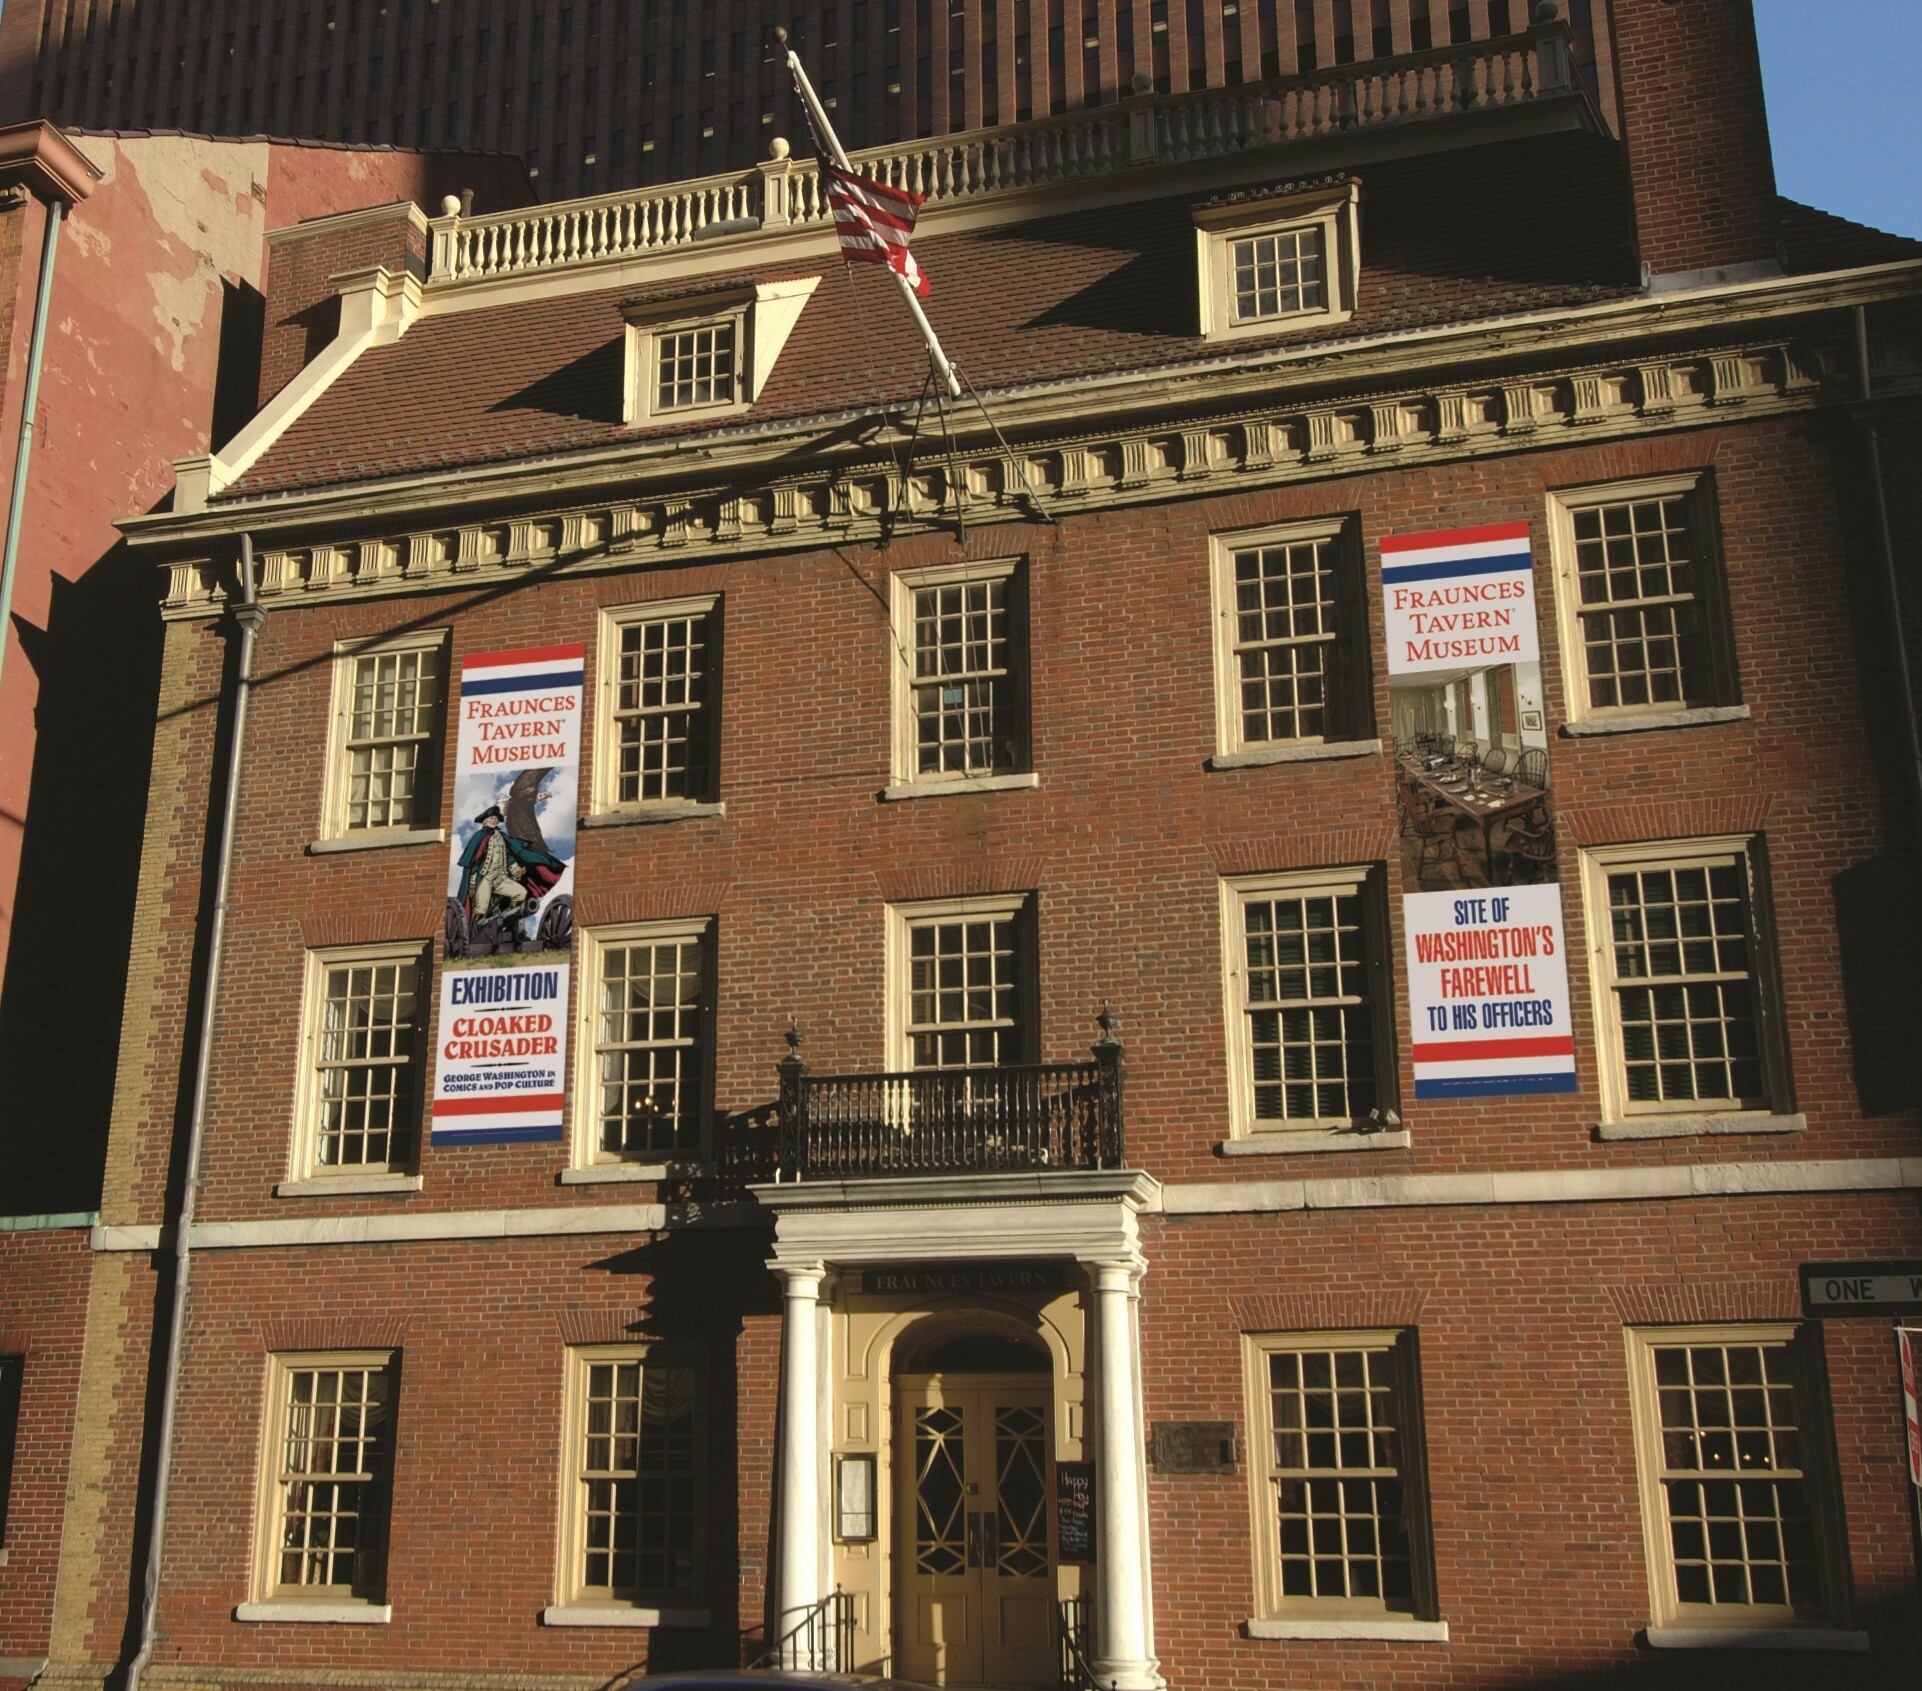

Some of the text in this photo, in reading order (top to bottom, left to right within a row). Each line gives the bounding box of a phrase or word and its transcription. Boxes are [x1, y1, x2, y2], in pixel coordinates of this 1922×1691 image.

[1393, 580, 1525, 610] FRAUNCES
[1406, 634, 1521, 662] MUSEUM
[467, 695, 575, 719] FRAUNCES
[471, 742, 566, 765] MUSEUM
[1454, 897, 1510, 925] SITE OF
[1415, 925, 1554, 964] WASHINGTON'S
[451, 972, 558, 1005] EXHIBITION
[1440, 964, 1535, 998] FAREWELL
[452, 1013, 553, 1038] CLOAKED
[1427, 999, 1553, 1031] TO HIS OFFICERS
[444, 1036, 558, 1060] CRUSADER
[443, 1073, 482, 1083] GEORGE
[482, 1069, 545, 1081] WASHINGTON
[443, 1082, 477, 1093] COMICS
[494, 1081, 514, 1090] POP
[515, 1079, 555, 1089] CULTURE
[876, 1271, 1047, 1290] FRAUNCES TAVERN
[1825, 1279, 1875, 1301] ONE
[1061, 1471, 1088, 1490] Happy
